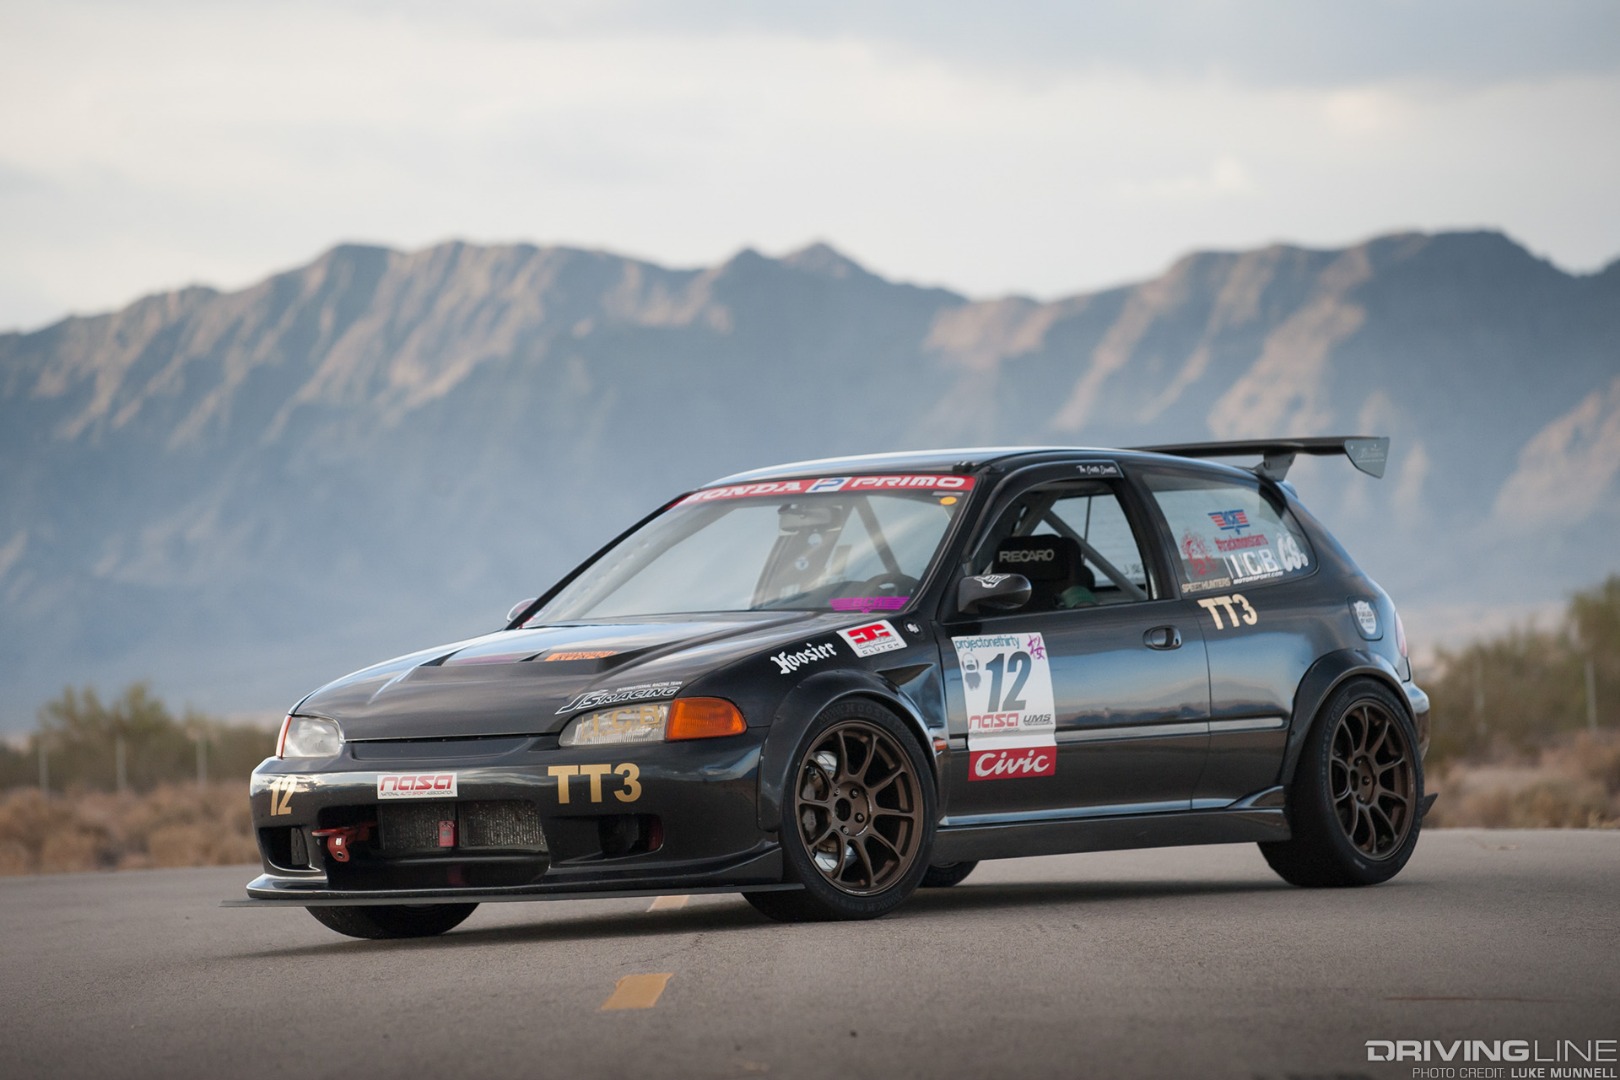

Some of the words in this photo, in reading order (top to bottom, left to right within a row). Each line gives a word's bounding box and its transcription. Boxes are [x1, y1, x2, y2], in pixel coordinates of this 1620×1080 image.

[851, 477, 965, 488] PRIMO
[999, 549, 1054, 563] RECARO
[1197, 593, 1258, 630] TT3
[861, 642, 900, 655] CLUTCH
[955, 635, 1020, 652] projectonethirty
[770, 643, 837, 675] Hoosier
[985, 651, 1032, 713] 12
[969, 712, 1019, 729] nasa
[1023, 713, 1051, 723] UMS
[975, 750, 1050, 777] Civic
[380, 775, 453, 791] nasa
[548, 763, 642, 804] TT3
[269, 775, 298, 817] 12
